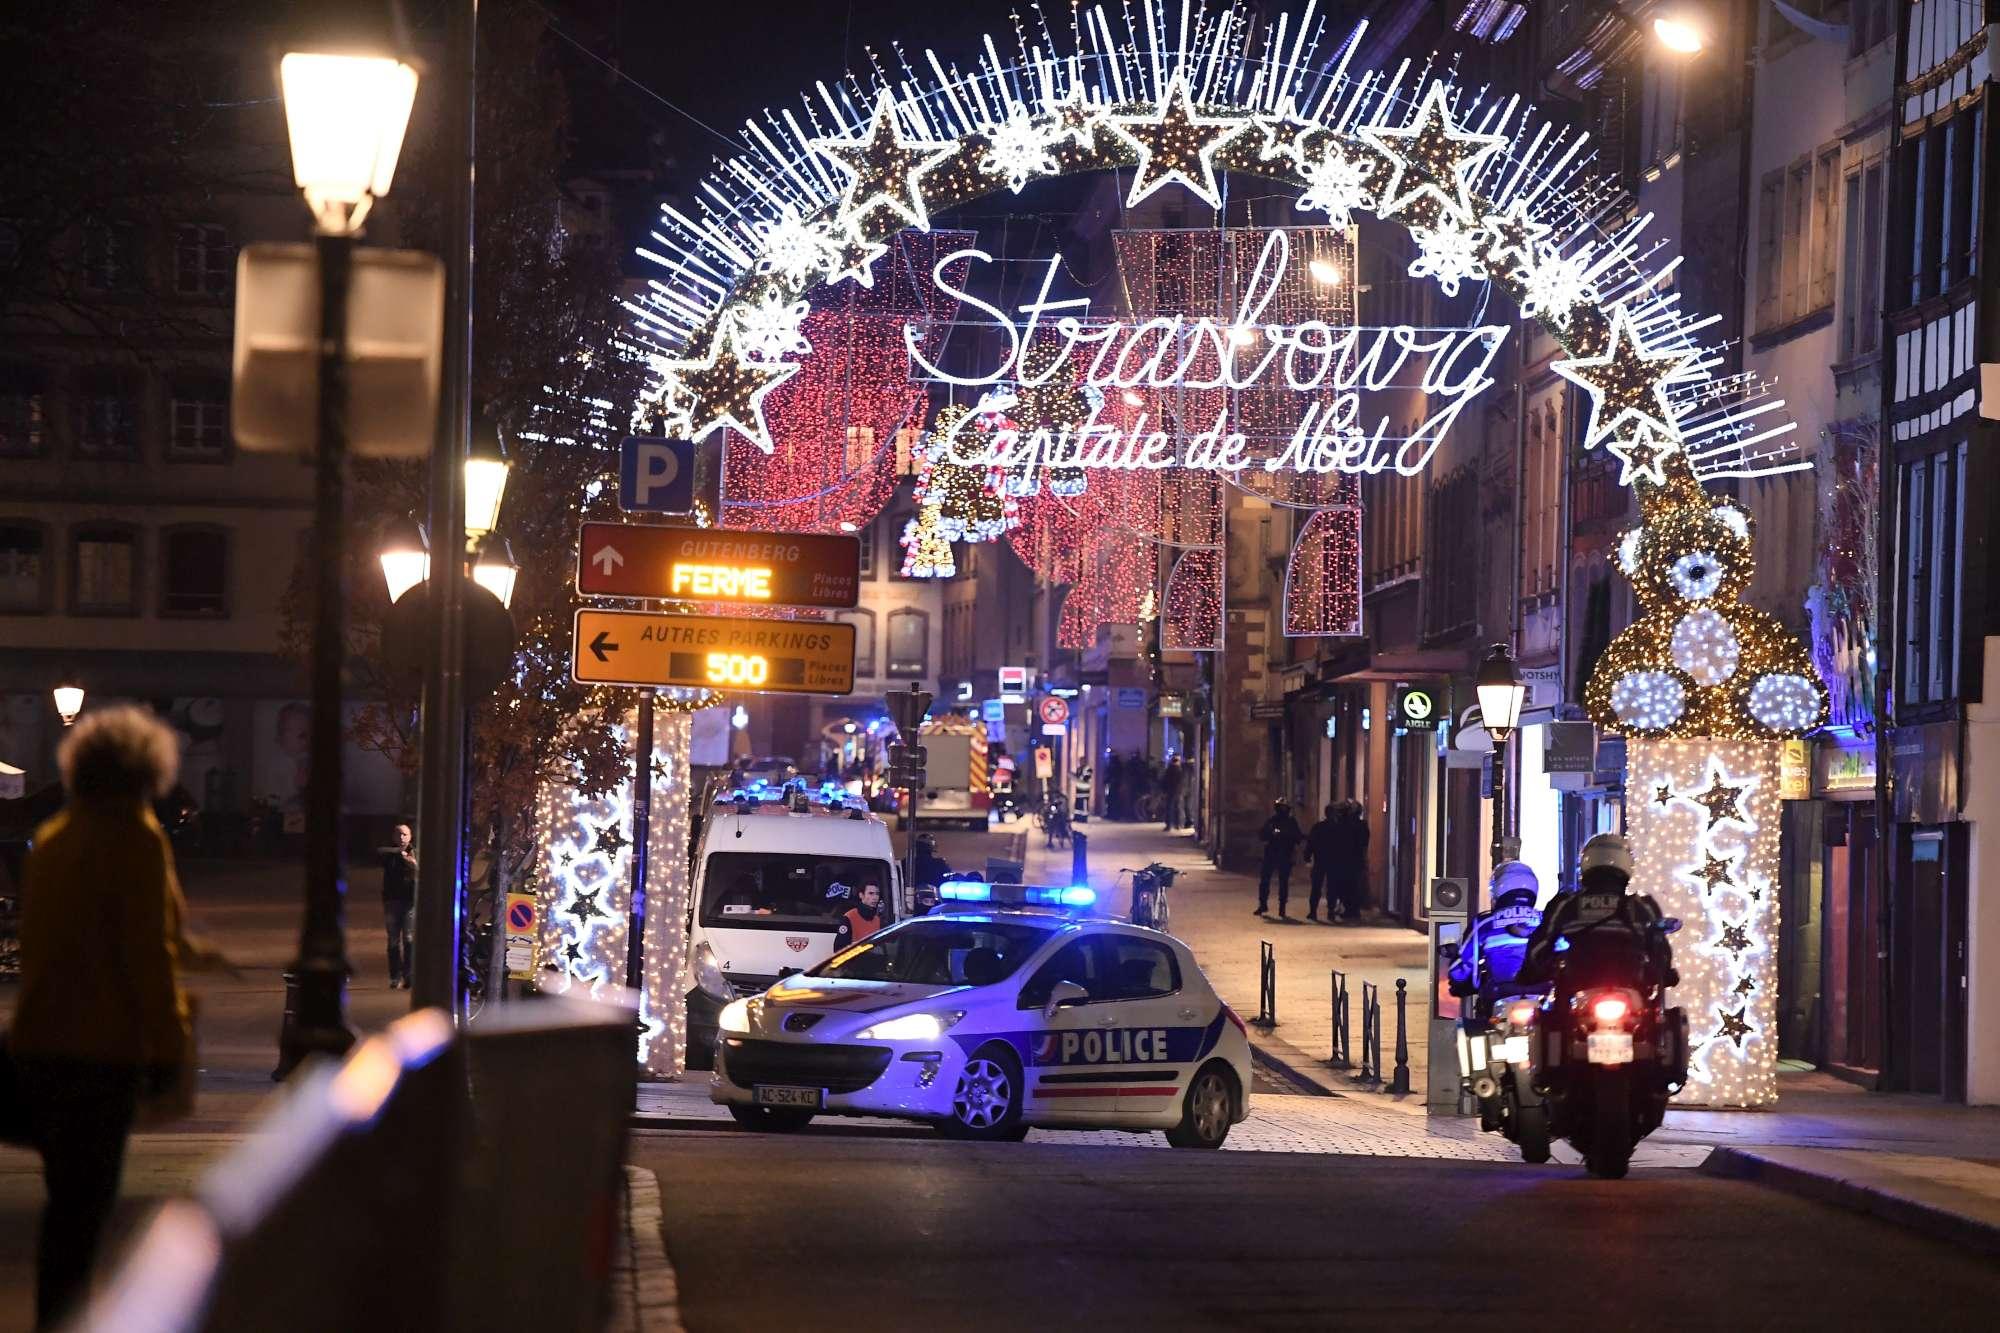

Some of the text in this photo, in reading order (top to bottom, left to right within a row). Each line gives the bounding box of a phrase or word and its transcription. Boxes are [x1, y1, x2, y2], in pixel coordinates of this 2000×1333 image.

[903, 228, 1511, 476] Strasbourg
[946, 404, 1175, 493] Capitale
[1185, 411, 1252, 470] de
[636, 444, 678, 505] P
[681, 541, 799, 561] GUTENBERG
[673, 563, 772, 598] FERME
[812, 587, 849, 599] Libres
[640, 625, 832, 651] AUTRES PARKINGS
[705, 652, 768, 686] 500
[1405, 719, 1431, 729] AIGLE
[723, 960, 731, 970] 4
[1062, 1030, 1168, 1063] POLICE
